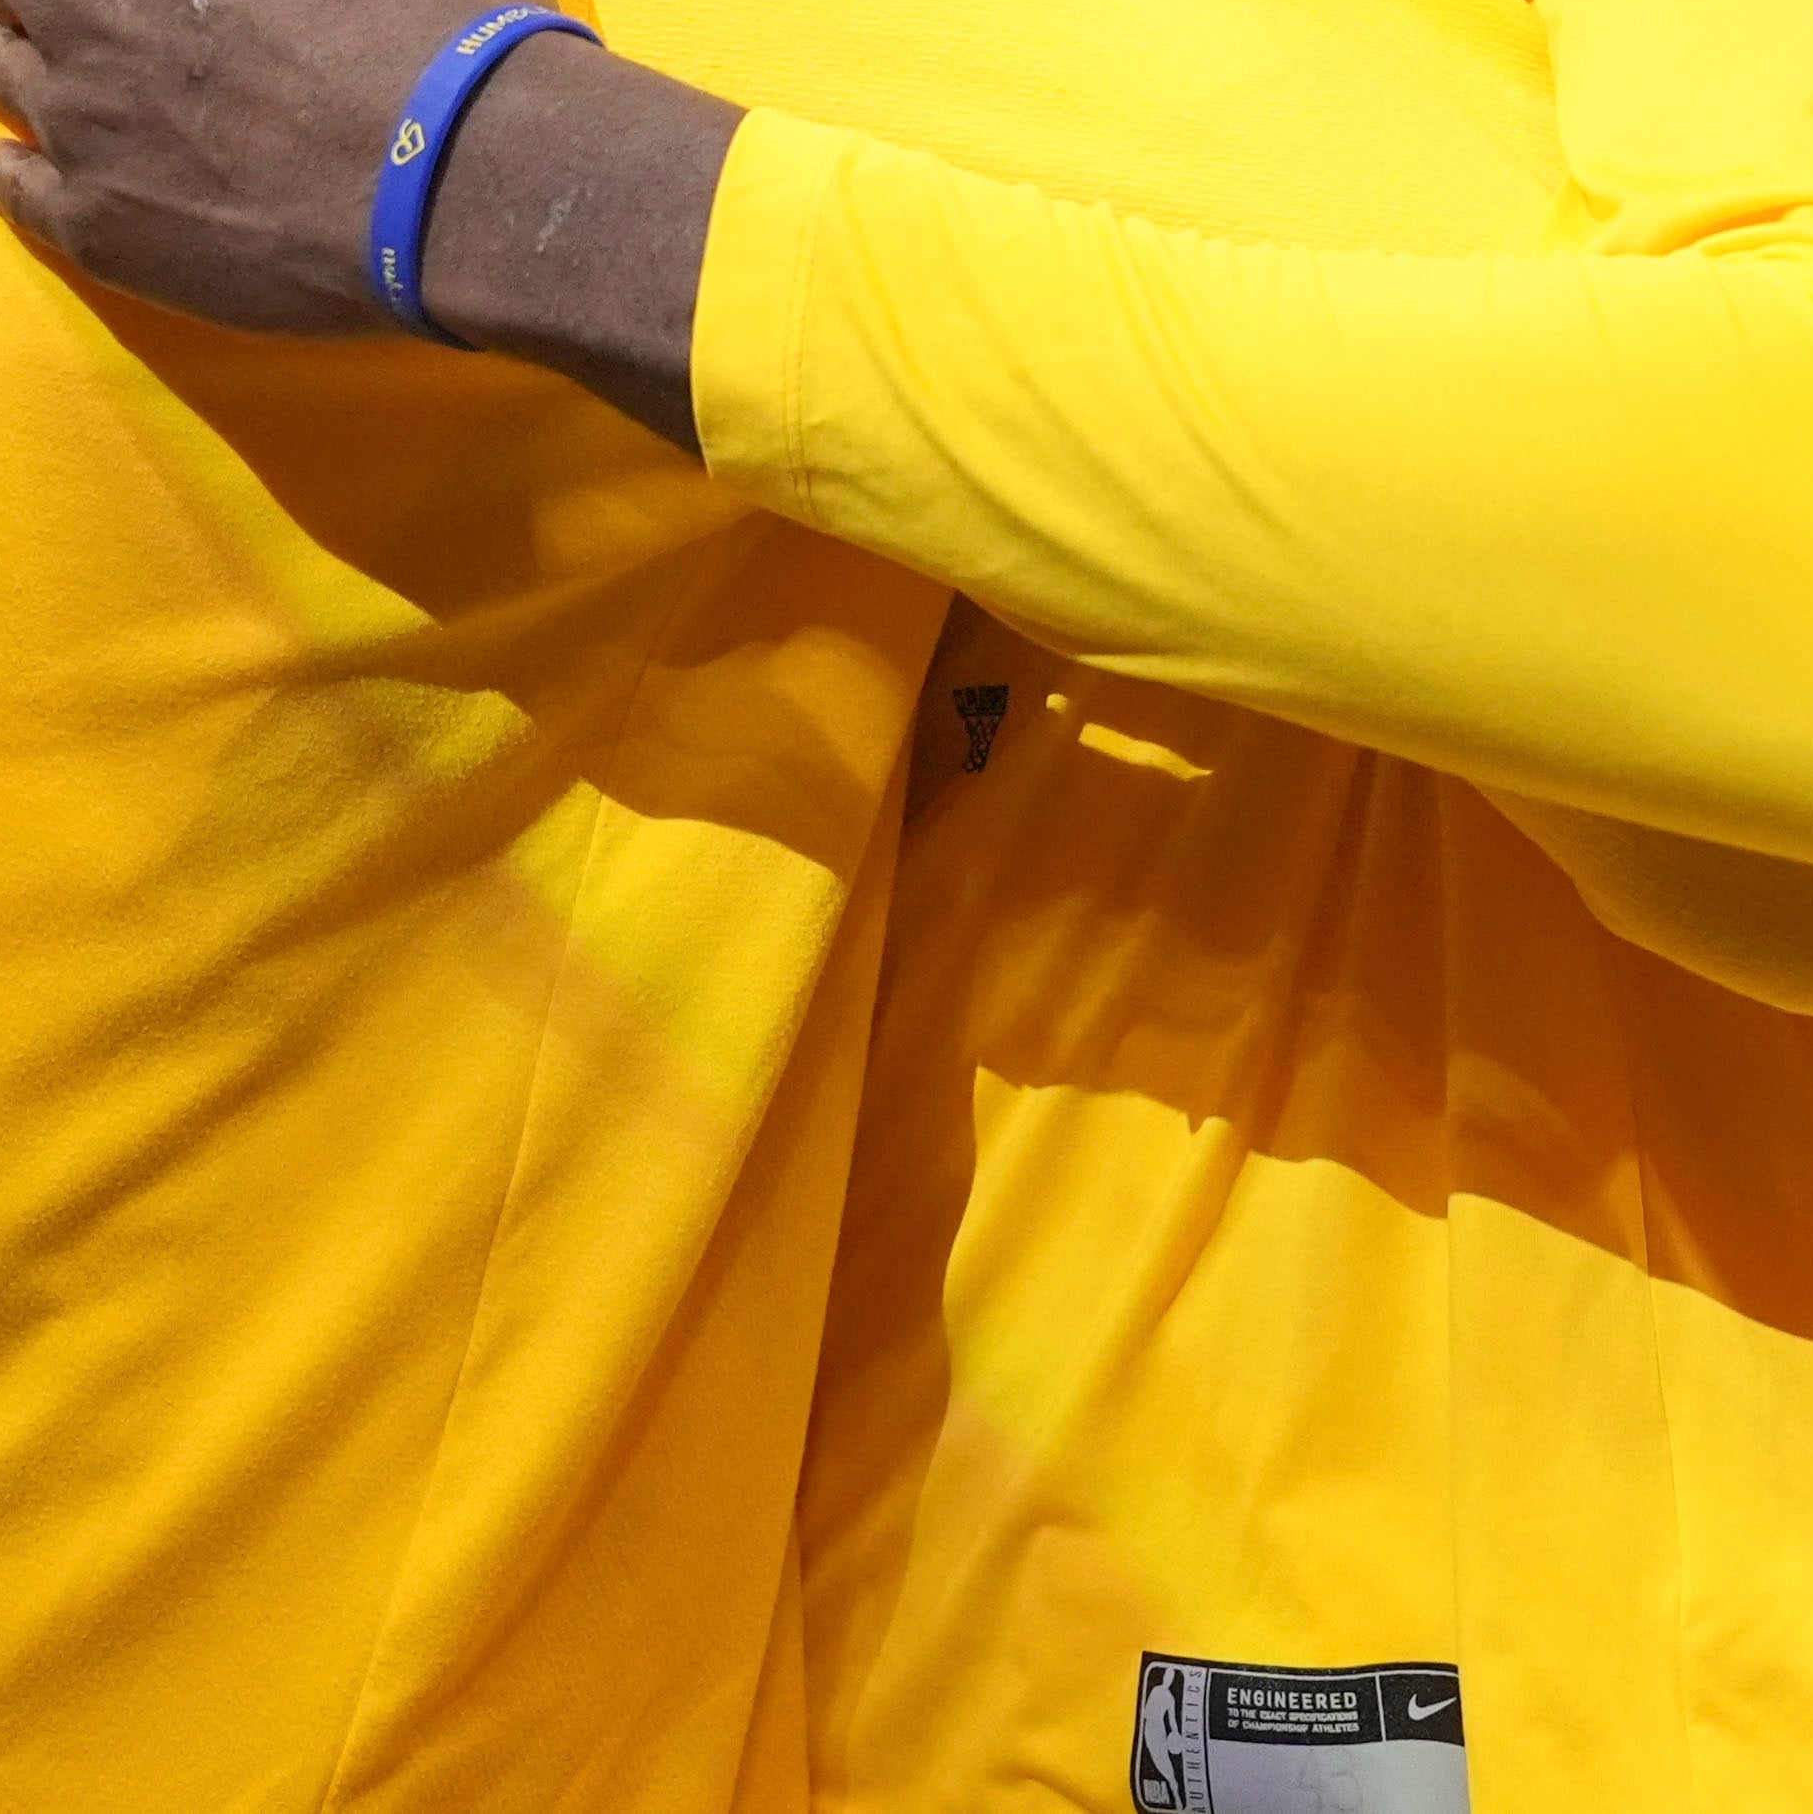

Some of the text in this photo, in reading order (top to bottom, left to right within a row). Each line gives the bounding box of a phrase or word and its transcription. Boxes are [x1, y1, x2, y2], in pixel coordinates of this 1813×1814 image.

[1227, 1687, 1358, 1710] ENGINEERED
[1227, 1707, 1359, 1722] TO THE EXACT SPECIFICATIONS
[1227, 1719, 1240, 1729] OF
[1311, 1722, 1360, 1733] ATHLETES
[1185, 1669, 1207, 1814] AUTHENTICS
